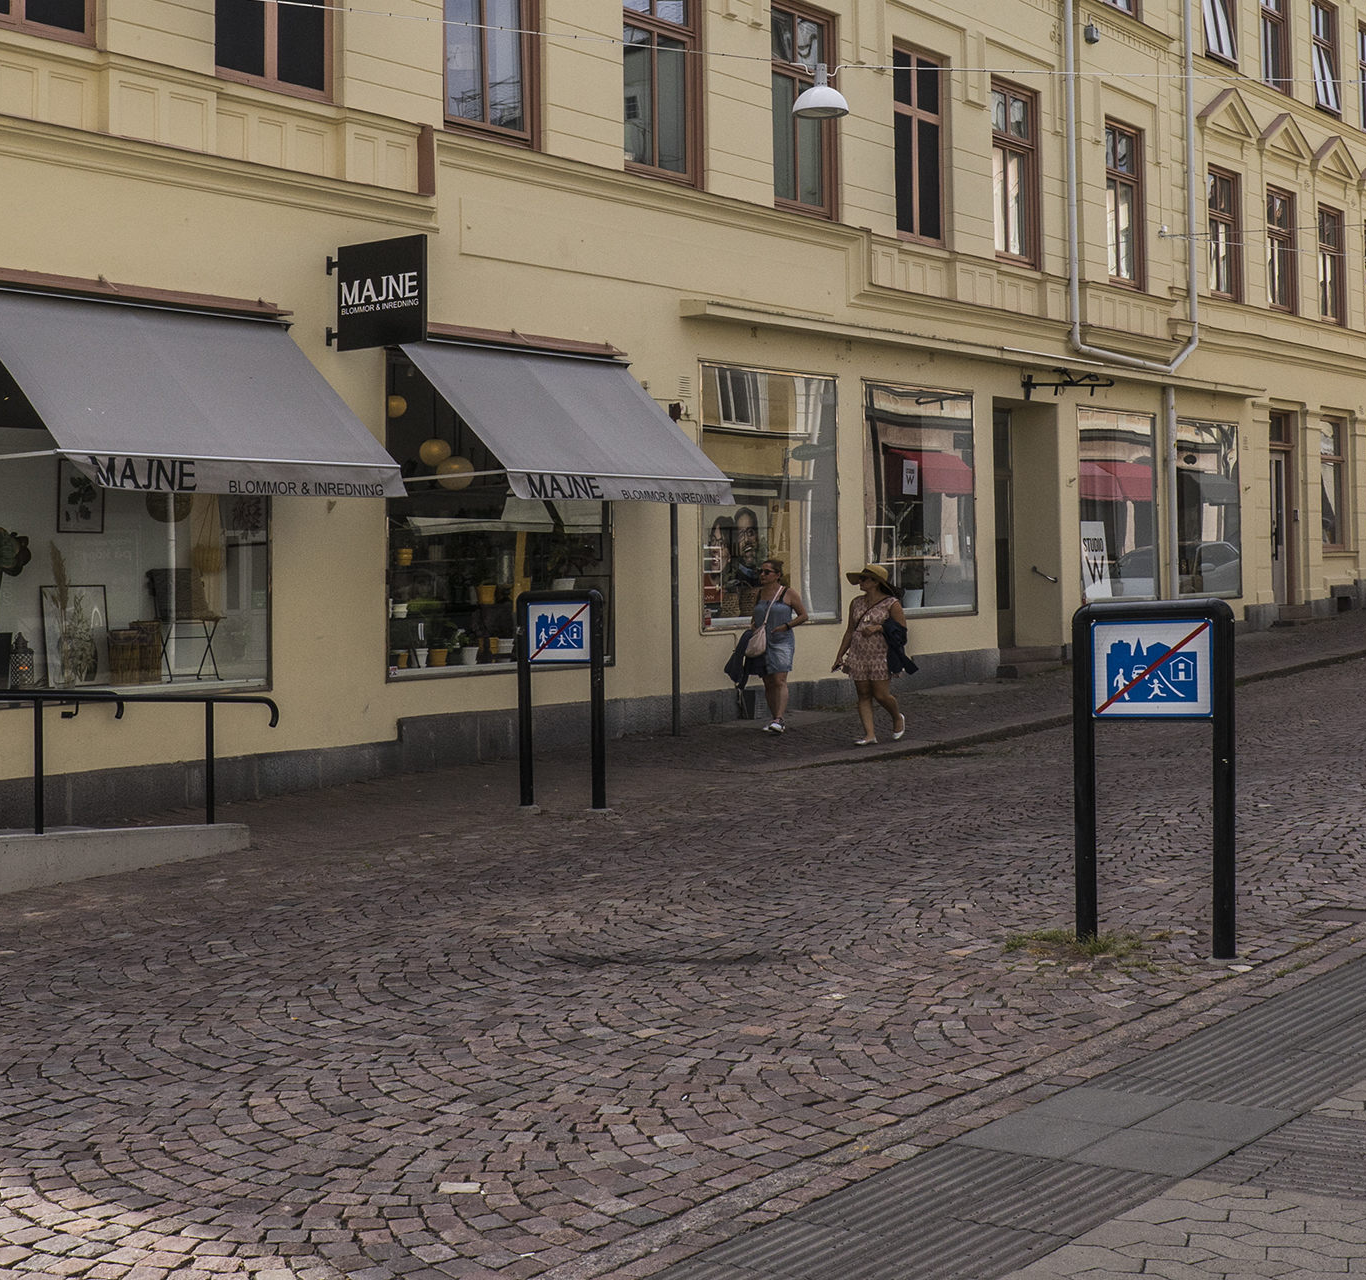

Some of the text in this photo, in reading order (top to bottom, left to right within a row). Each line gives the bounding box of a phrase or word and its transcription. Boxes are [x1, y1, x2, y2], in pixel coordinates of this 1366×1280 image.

[340, 271, 419, 307] MAJNE
[341, 298, 419, 316] BLOMMOR & INREDNING
[88, 456, 197, 492] MAJNE
[229, 480, 384, 497] BLOMMOR & INREDNING
[526, 474, 604, 500] MAJNE
[621, 489, 721, 505] BLOMMOR & INREDNING
[1082, 537, 1104, 552] STUDIO
[1085, 554, 1104, 585] W
